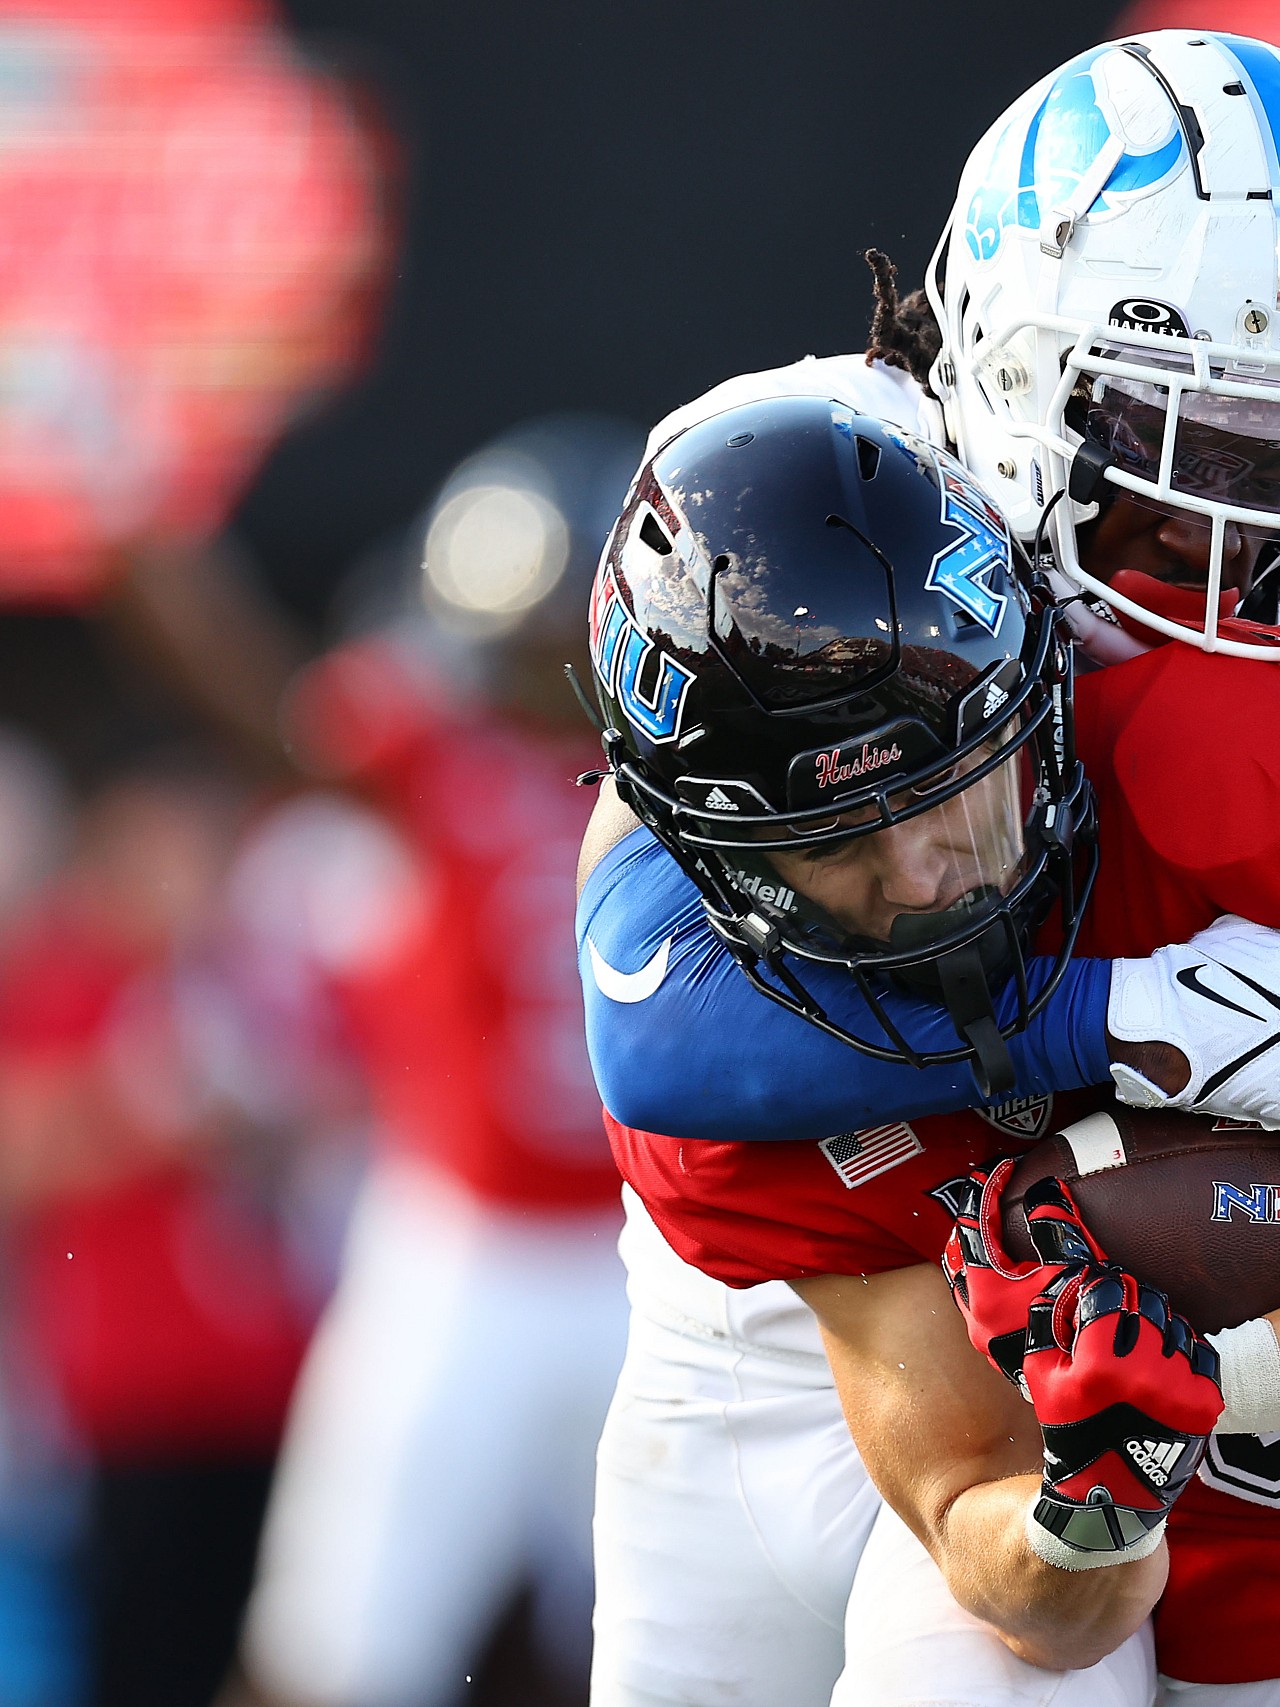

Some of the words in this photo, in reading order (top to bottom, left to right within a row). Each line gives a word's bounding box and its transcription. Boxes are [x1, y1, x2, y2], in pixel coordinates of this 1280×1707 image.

[1109, 318, 1183, 337] OAKLEY
[983, 691, 1009, 719] adidas
[815, 743, 903, 788] Huskies
[705, 800, 740, 812] adidas
[1126, 1440, 1168, 1487] adidas
